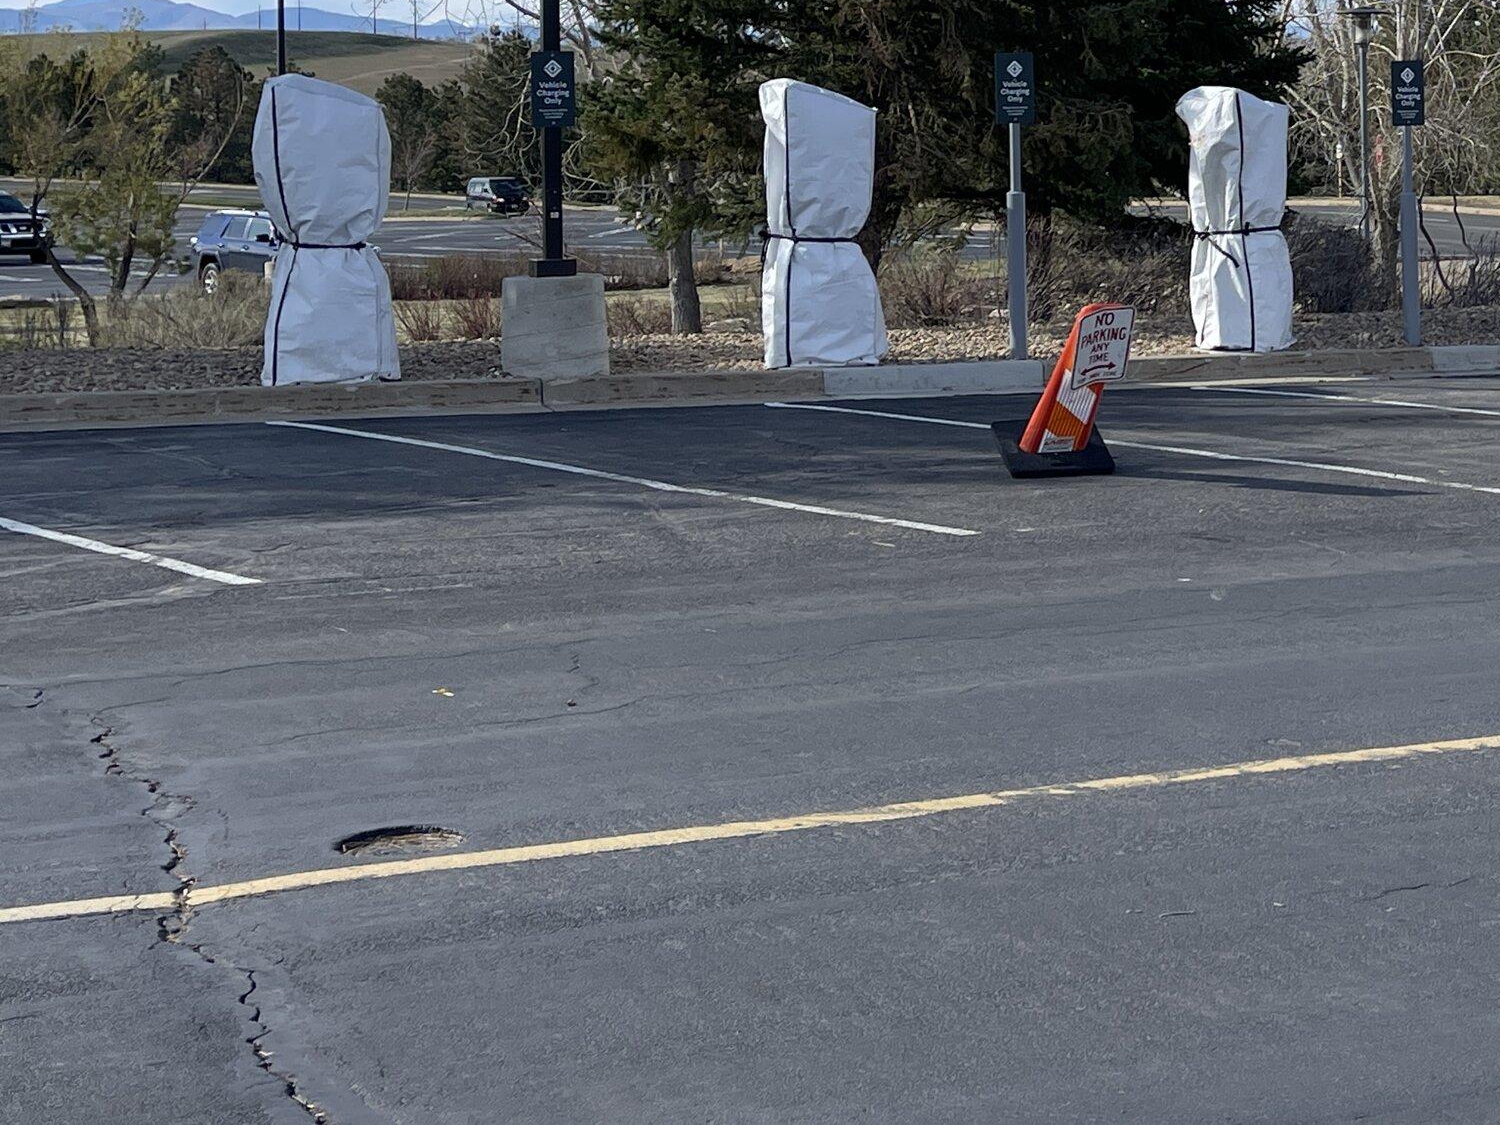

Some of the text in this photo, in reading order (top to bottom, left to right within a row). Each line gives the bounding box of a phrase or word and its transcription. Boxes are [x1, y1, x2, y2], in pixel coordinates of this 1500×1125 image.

[1094, 312, 1115, 328] NO
[1081, 327, 1127, 349] PARKING
[1090, 342, 1110, 354] ANY
[1088, 352, 1109, 364] TIME
